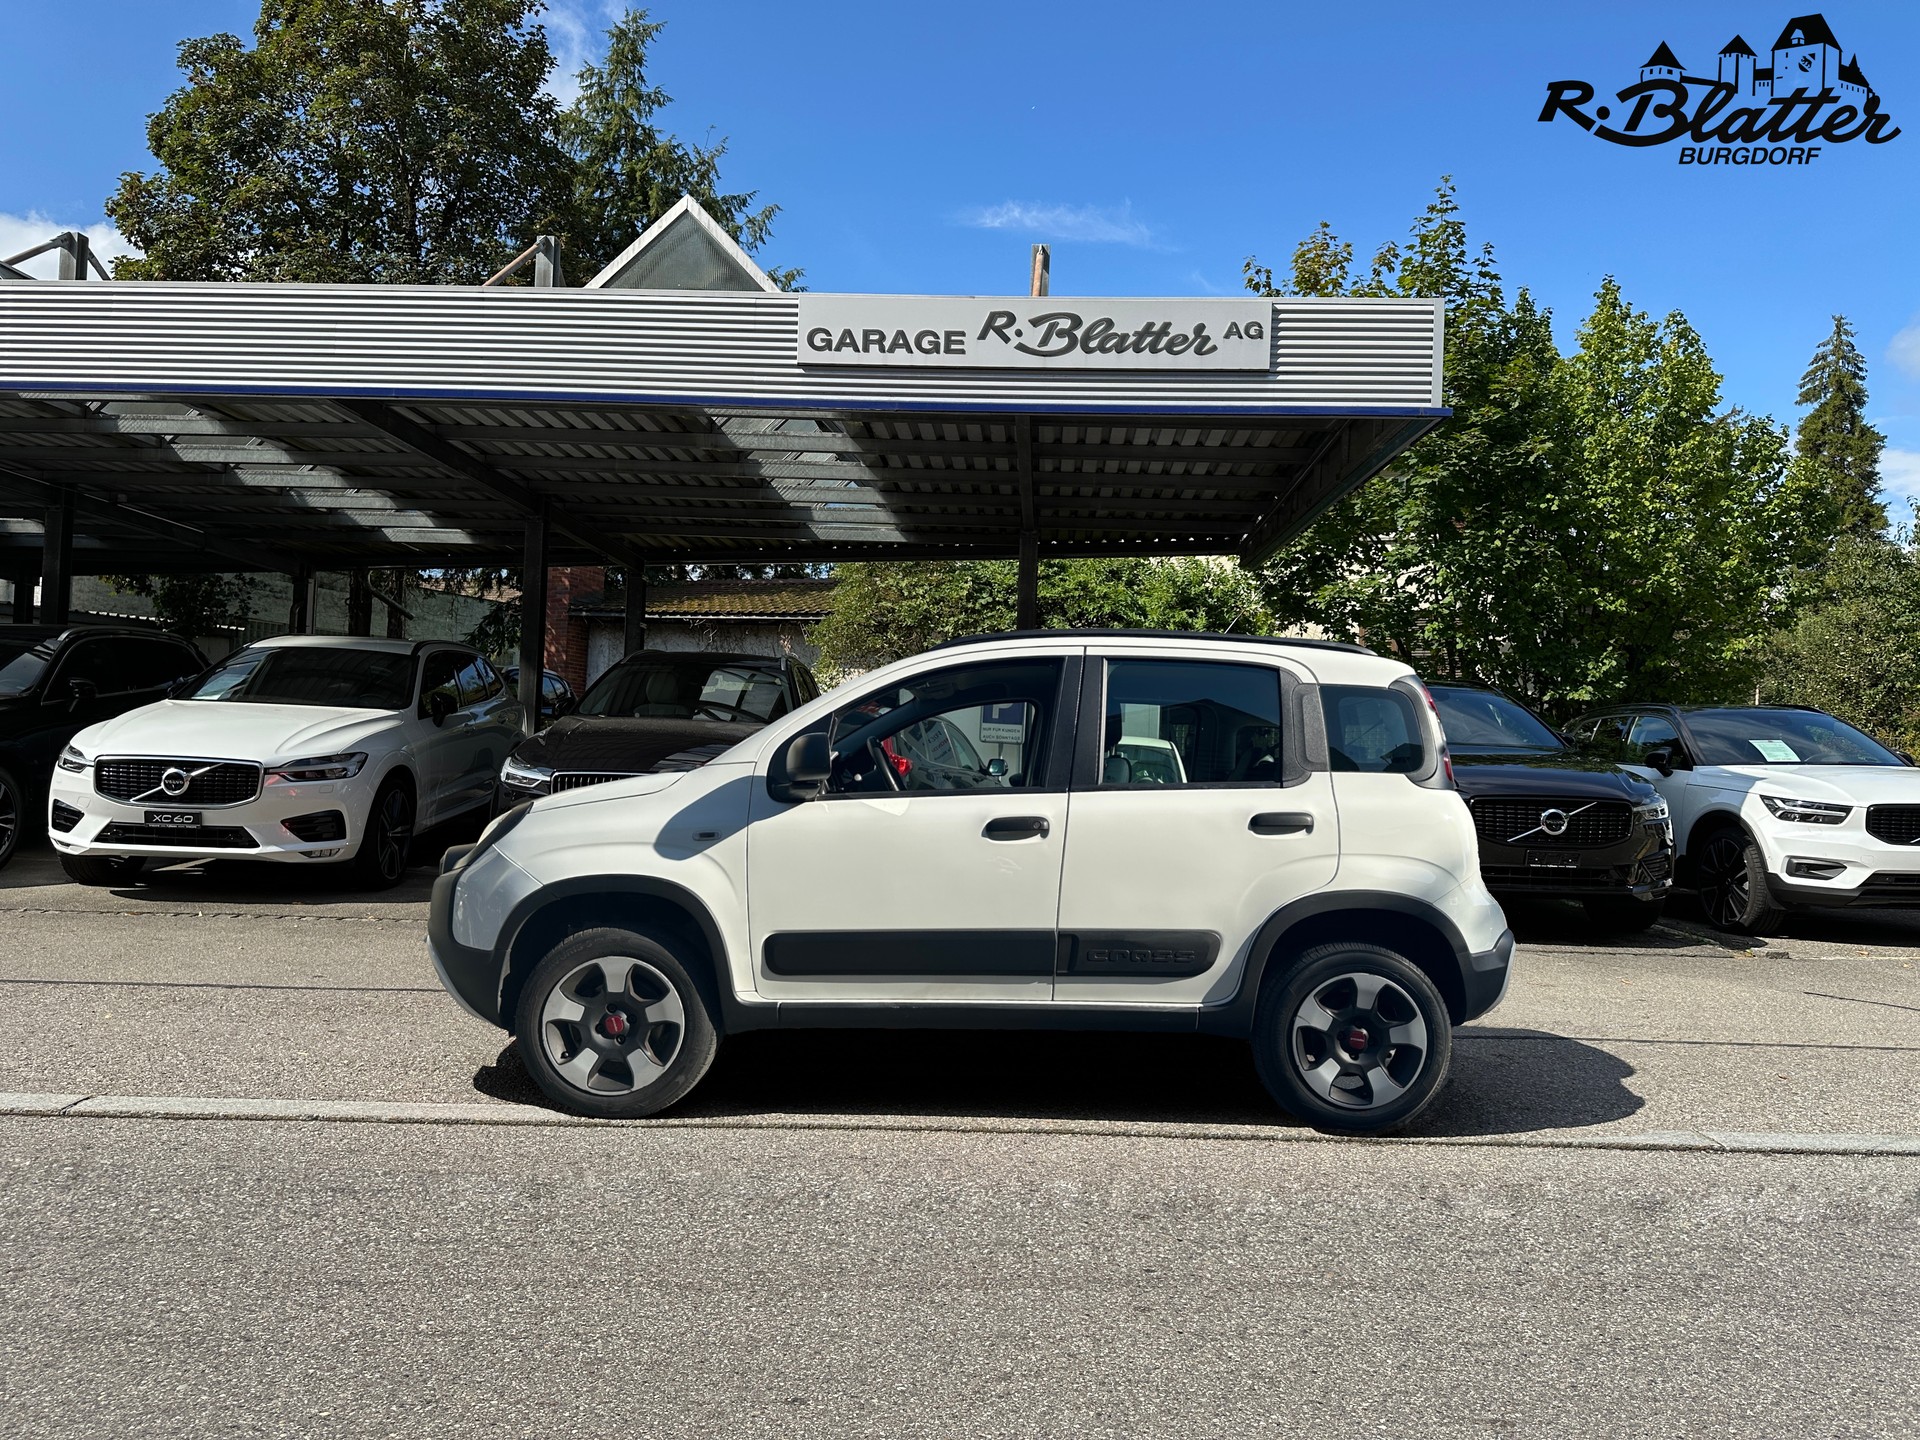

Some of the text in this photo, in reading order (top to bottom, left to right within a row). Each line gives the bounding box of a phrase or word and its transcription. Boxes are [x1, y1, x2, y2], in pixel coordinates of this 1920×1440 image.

[806, 327, 967, 355] GARAGE
[1223, 321, 1264, 340] AG
[1087, 949, 1195, 963] CROSS
